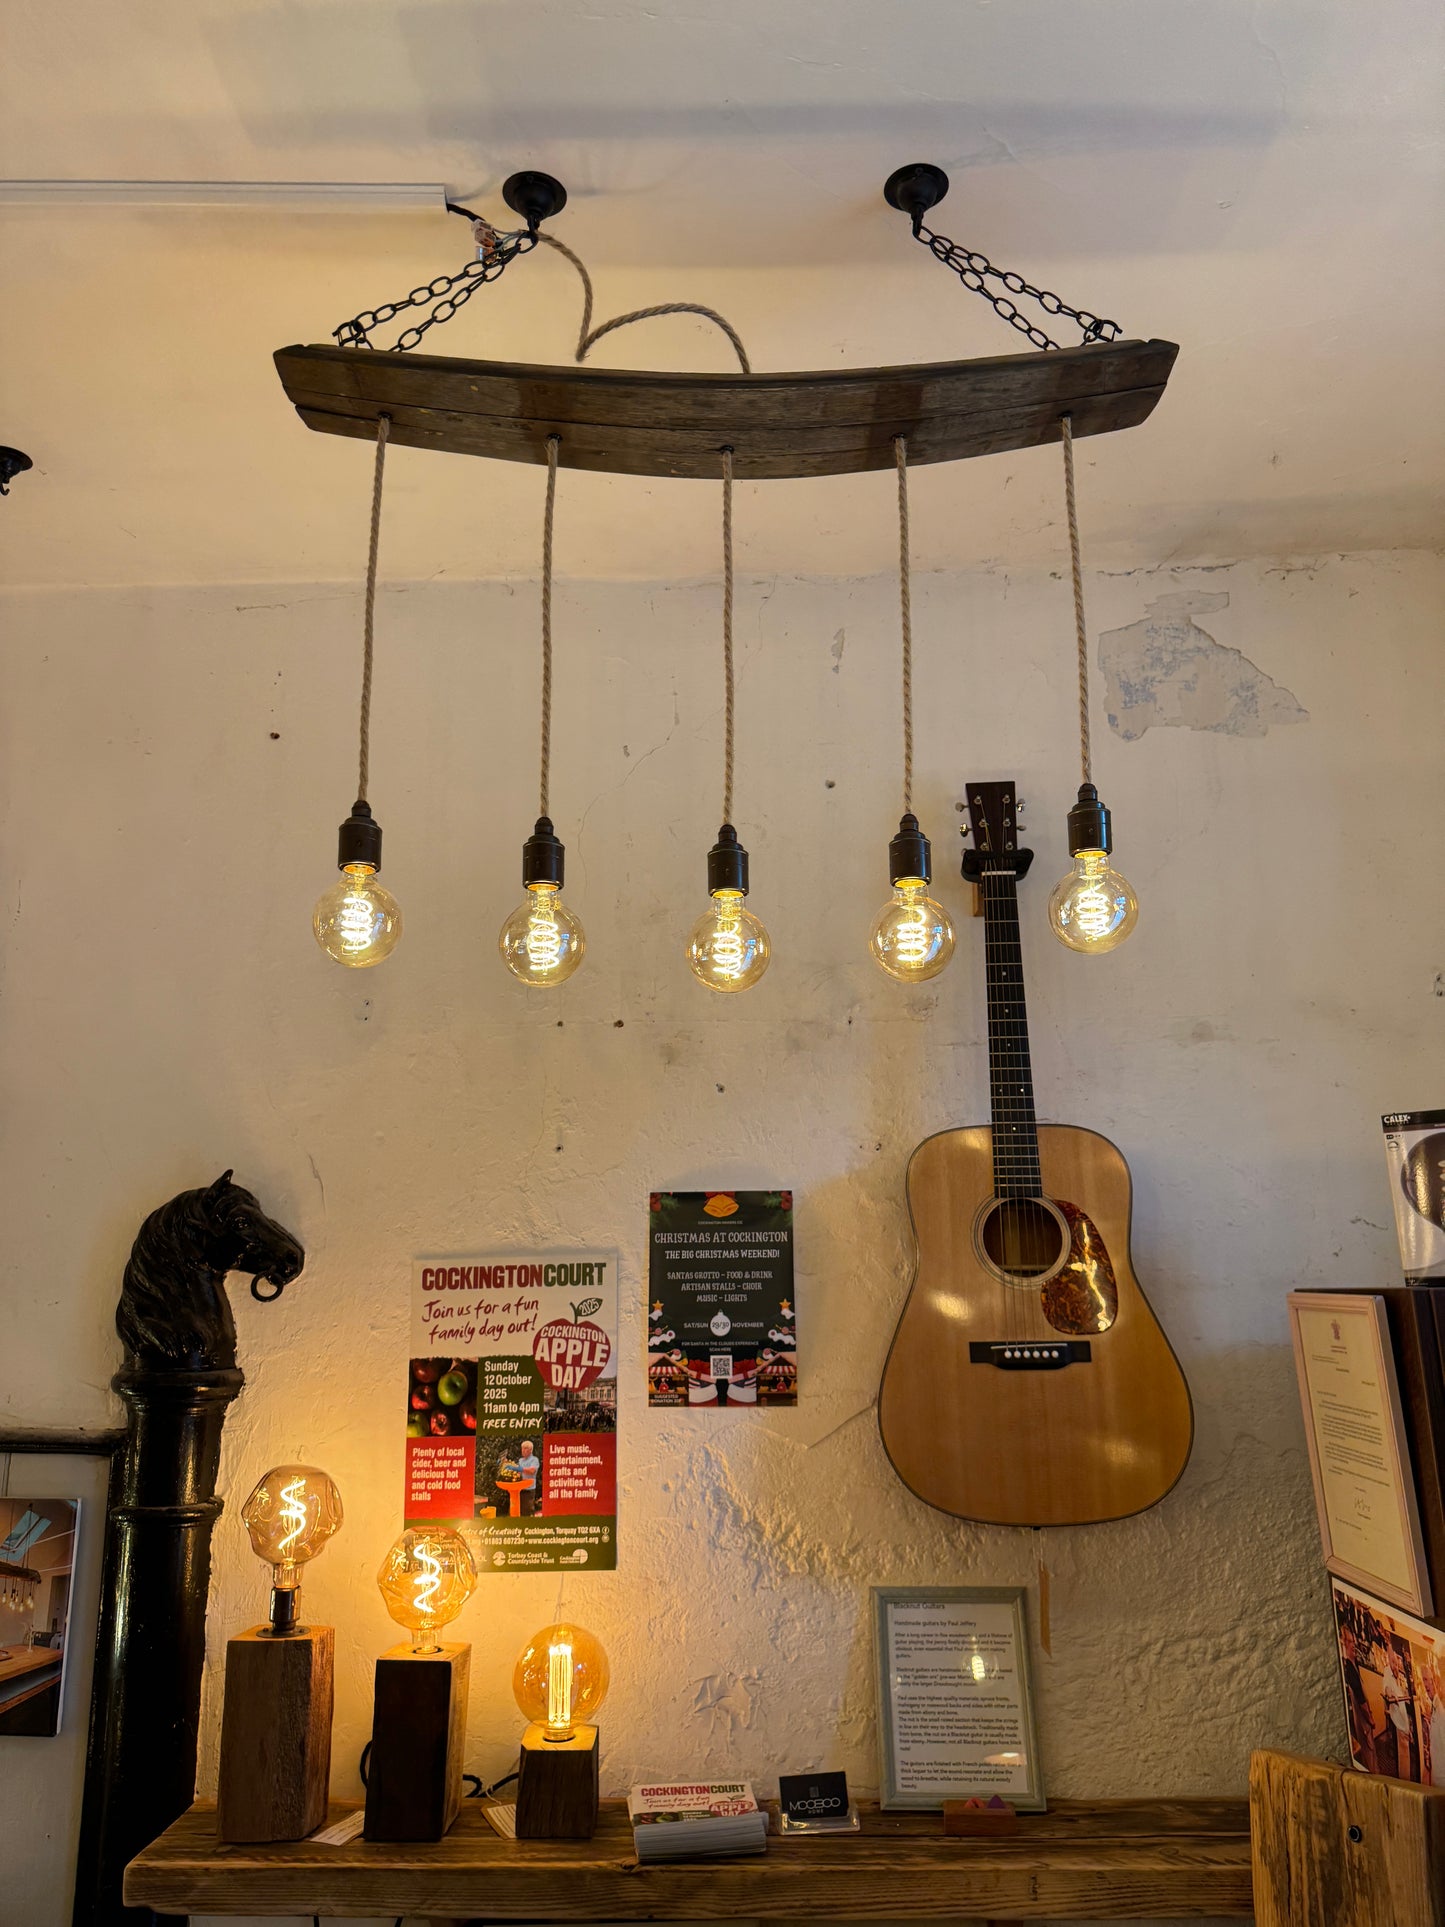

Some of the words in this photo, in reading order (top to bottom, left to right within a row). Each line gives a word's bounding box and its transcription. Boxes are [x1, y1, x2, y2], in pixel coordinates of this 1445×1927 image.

[1384, 1114, 1408, 1124] CALEX
[654, 1232, 710, 1244] CHRISTMAS
[713, 1232, 726, 1242] AT
[728, 1231, 788, 1242] COCKINGTON
[665, 1250, 680, 1259] THE
[682, 1250, 694, 1259] BIG
[695, 1250, 739, 1259] CHRISTMAS
[741, 1249, 780, 1258] WEEKEND!
[694, 1271, 720, 1279] GROTTO
[726, 1271, 743, 1279] FOOD
[751, 1271, 773, 1279] DRINK
[681, 1283, 711, 1291] ARTISAN
[724, 1294, 747, 1302] LIGHTS
[422, 1299, 454, 1322] Join
[457, 1305, 471, 1316] us
[474, 1299, 499, 1320] for
[502, 1303, 511, 1313] a
[514, 1296, 539, 1316] fun
[579, 1299, 600, 1316] 2025
[429, 1321, 475, 1344] family
[479, 1318, 504, 1341] day
[508, 1313, 537, 1333] out!
[712, 1321, 729, 1329] 29/30
[540, 1326, 606, 1343] COCKINGTON
[535, 1338, 609, 1367] APPLE
[484, 1360, 519, 1373] Sunday
[484, 1374, 495, 1385] 12
[496, 1374, 532, 1385] October
[551, 1364, 587, 1388] DAY
[484, 1388, 507, 1400] 2025
[483, 1402, 507, 1414] 11am
[508, 1402, 518, 1413] to
[519, 1402, 540, 1415] 4pm
[483, 1418, 508, 1429] FREE
[509, 1416, 542, 1429] ENTRY
[413, 1448, 436, 1458] Plenty
[437, 1447, 445, 1456] of
[446, 1446, 465, 1456] local
[550, 1445, 565, 1454] Live
[567, 1444, 592, 1454] music,
[412, 1458, 432, 1468] cider,
[434, 1458, 451, 1467] beer
[452, 1458, 467, 1467] and
[550, 1455, 603, 1465] entertainment,
[412, 1469, 445, 1478] delicious
[446, 1469, 458, 1478] hot
[549, 1467, 571, 1476] crafts
[573, 1466, 587, 1476] and
[412, 1480, 425, 1490] and
[427, 1480, 443, 1490] cold
[444, 1480, 461, 1490] food
[549, 1478, 583, 1487] activities
[585, 1477, 596, 1486] for
[411, 1491, 431, 1501] stalls
[549, 1489, 559, 1498] all
[560, 1489, 573, 1498] the
[574, 1488, 599, 1499] family
[489, 1526, 522, 1537] Creativity
[524, 1527, 555, 1536] Cockington,
[556, 1526, 577, 1535] Torquay
